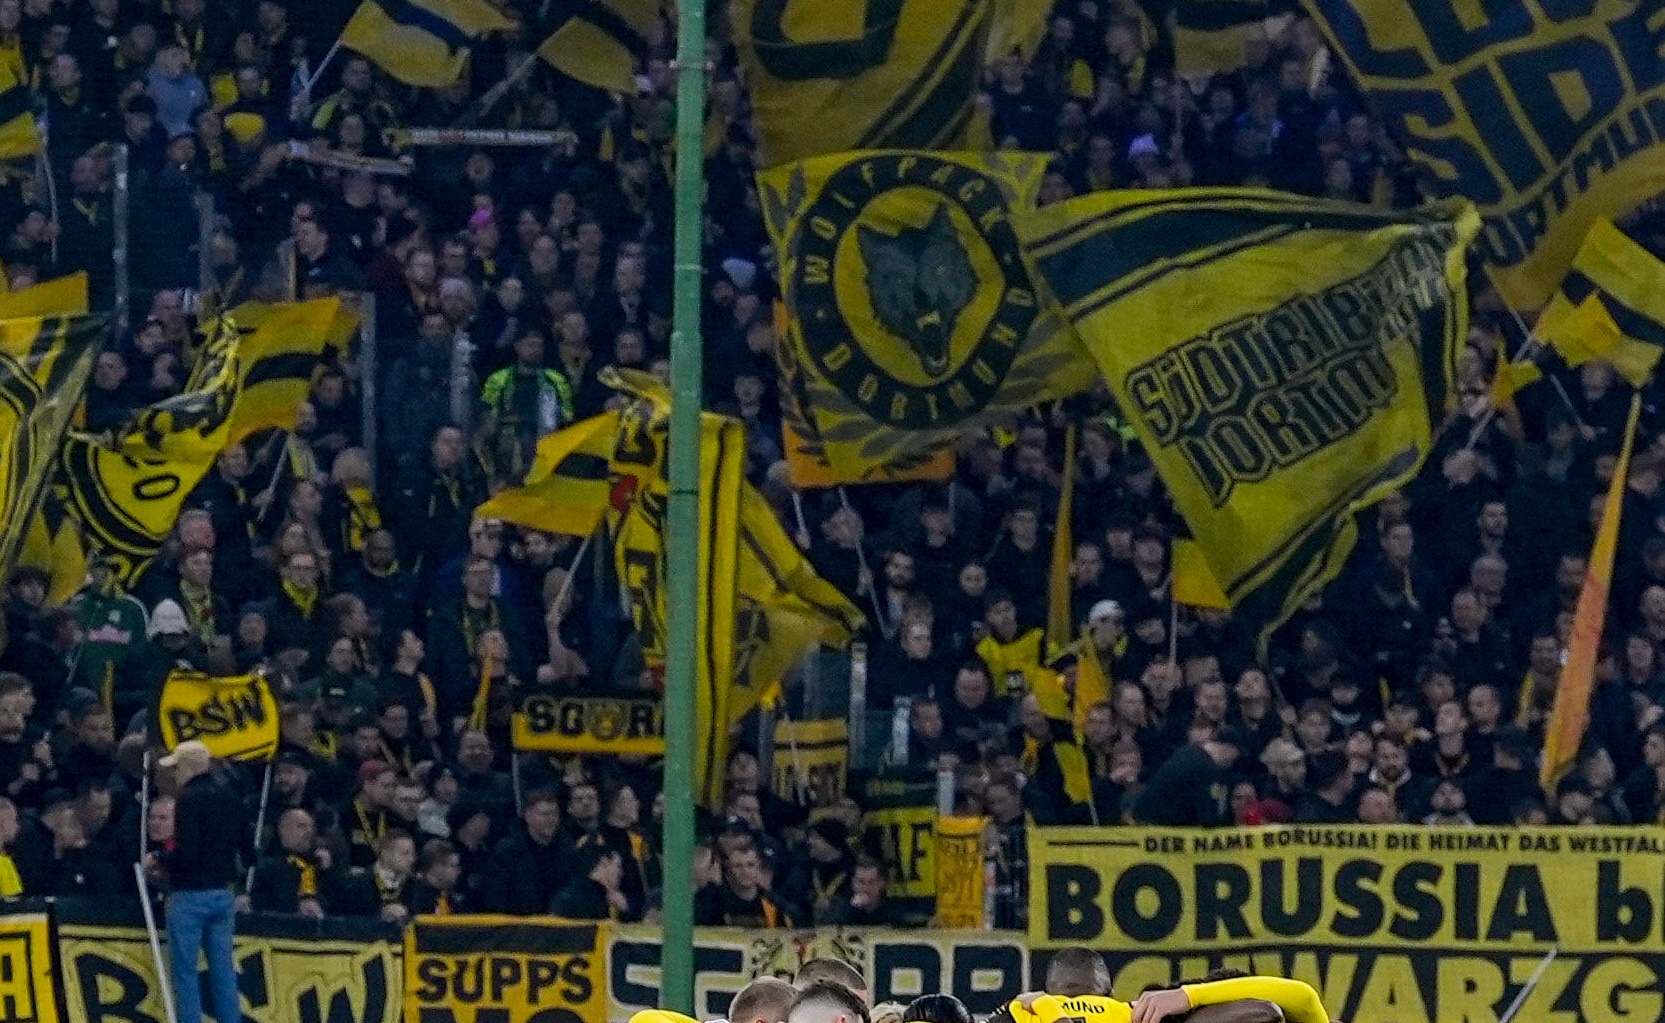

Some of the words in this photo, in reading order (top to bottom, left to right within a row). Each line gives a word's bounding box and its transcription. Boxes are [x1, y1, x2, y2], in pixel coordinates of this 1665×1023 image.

[166, 677, 267, 745] BSW
[1145, 836, 1185, 852] DER
[1194, 833, 1254, 851] NAME
[1386, 833, 1421, 851] DIE
[1428, 833, 1510, 851] HEIMAT
[1520, 835, 1562, 853] DAS
[1045, 856, 1559, 943] BORUSSIA
[416, 956, 593, 1005] SUPPS
